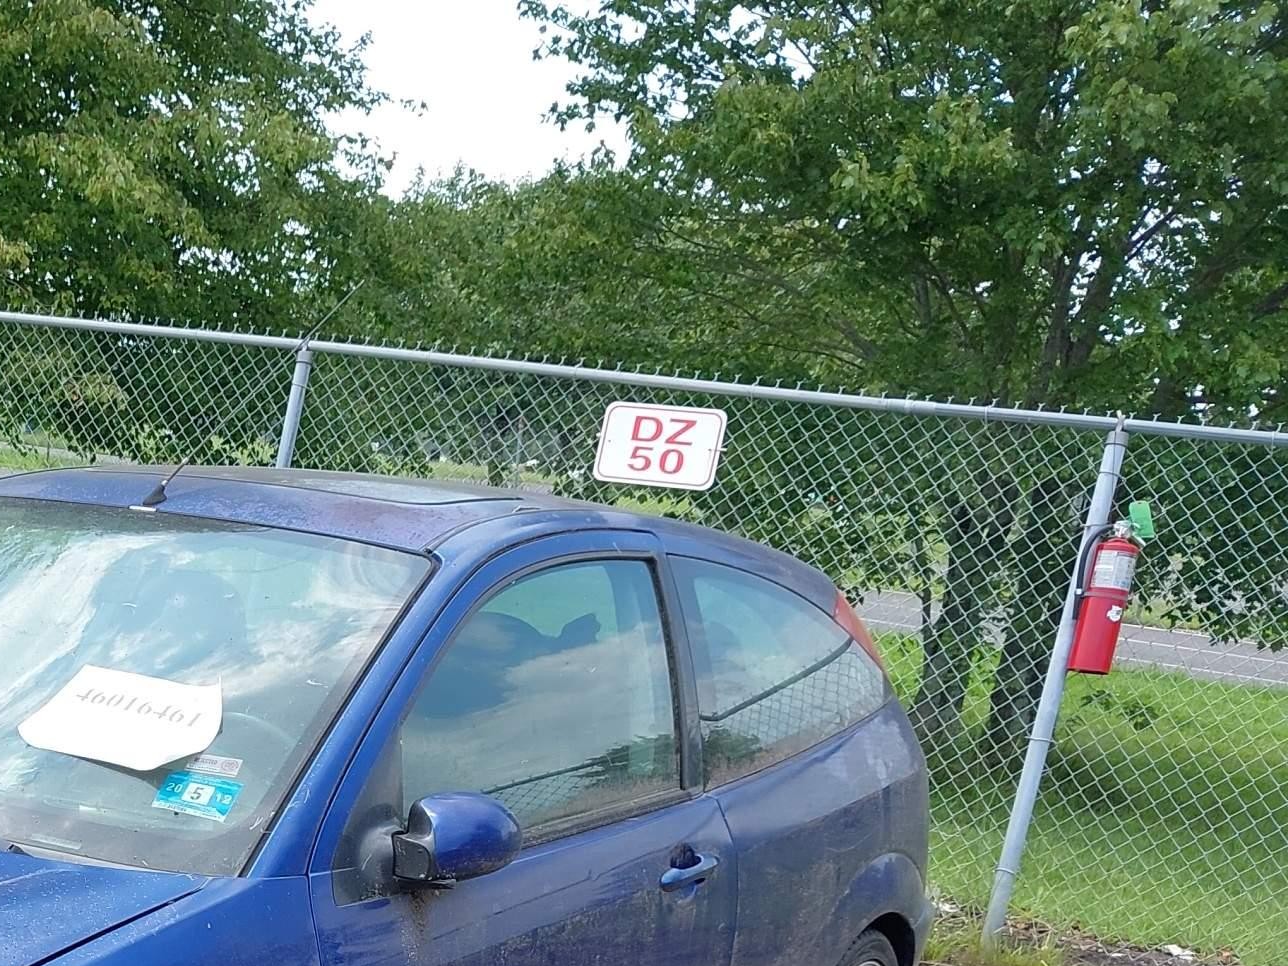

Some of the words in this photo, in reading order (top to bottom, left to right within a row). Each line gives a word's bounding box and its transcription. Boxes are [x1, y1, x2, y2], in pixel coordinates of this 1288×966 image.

[630, 415, 697, 446] DZ
[627, 446, 685, 475] 50
[75, 687, 203, 728] 46016461
[165, 782, 183, 793] 20
[190, 786, 205, 801] 5
